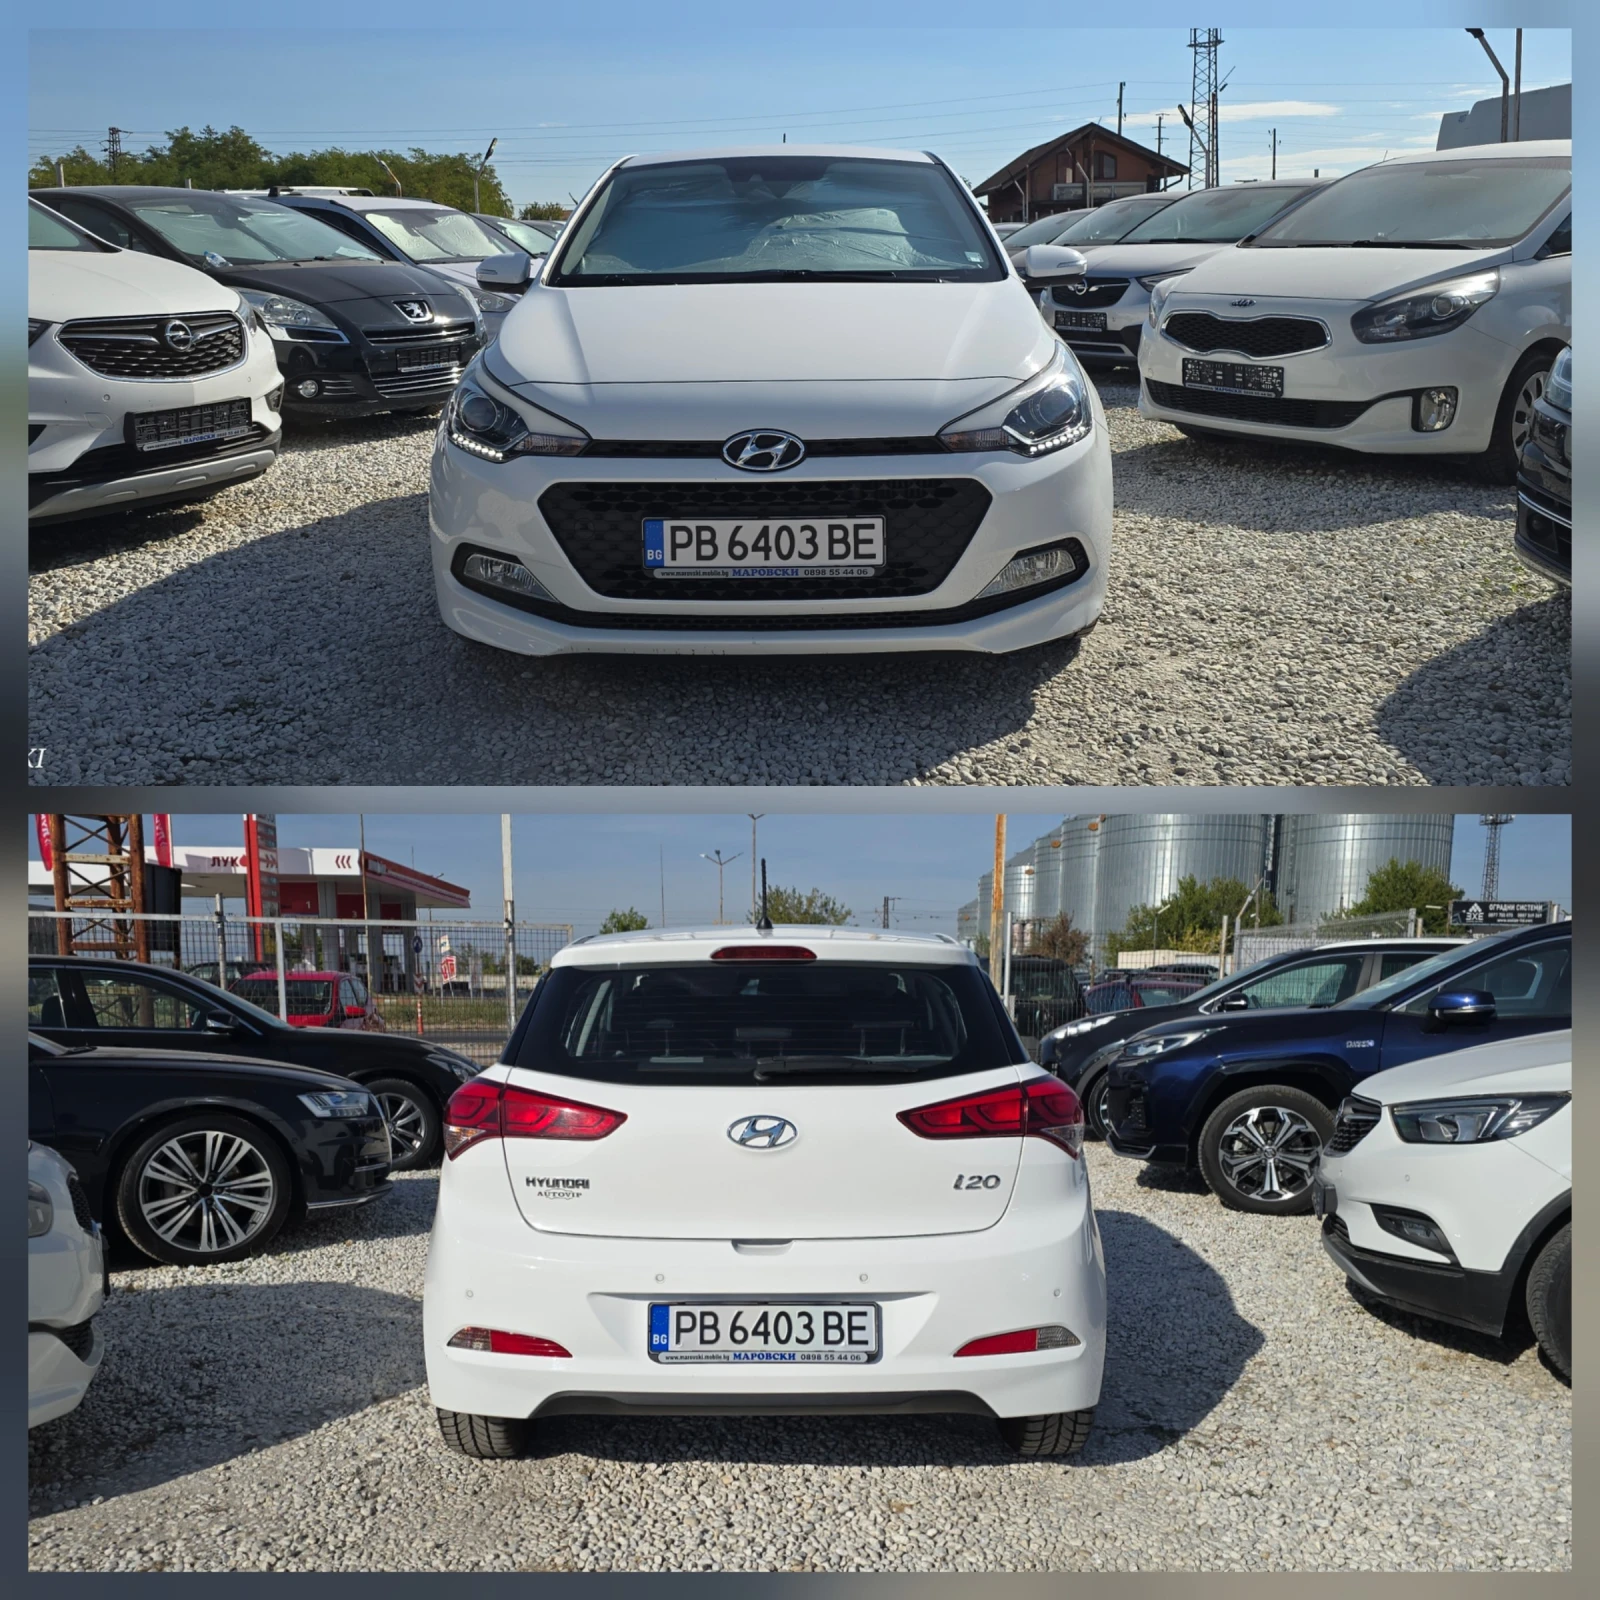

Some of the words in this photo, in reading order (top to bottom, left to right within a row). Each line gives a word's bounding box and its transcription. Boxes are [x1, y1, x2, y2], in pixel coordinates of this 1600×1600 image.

[669, 525, 719, 562] PB
[727, 524, 819, 562] 6403
[827, 523, 877, 561] BE
[647, 550, 663, 561] BG
[732, 568, 800, 577] МАРОВСКИ
[804, 568, 827, 576] 0898
[829, 568, 841, 576] 55
[842, 568, 855, 576] 44
[856, 568, 869, 576] 06
[525, 1176, 590, 1189] HYUNDAI
[953, 1174, 1001, 1190] i20
[675, 1310, 721, 1346] PB
[729, 1310, 815, 1346] 6403
[823, 1311, 869, 1346] BE
[652, 1334, 668, 1345] BG
[733, 1352, 796, 1361] МАРОВСКИ
